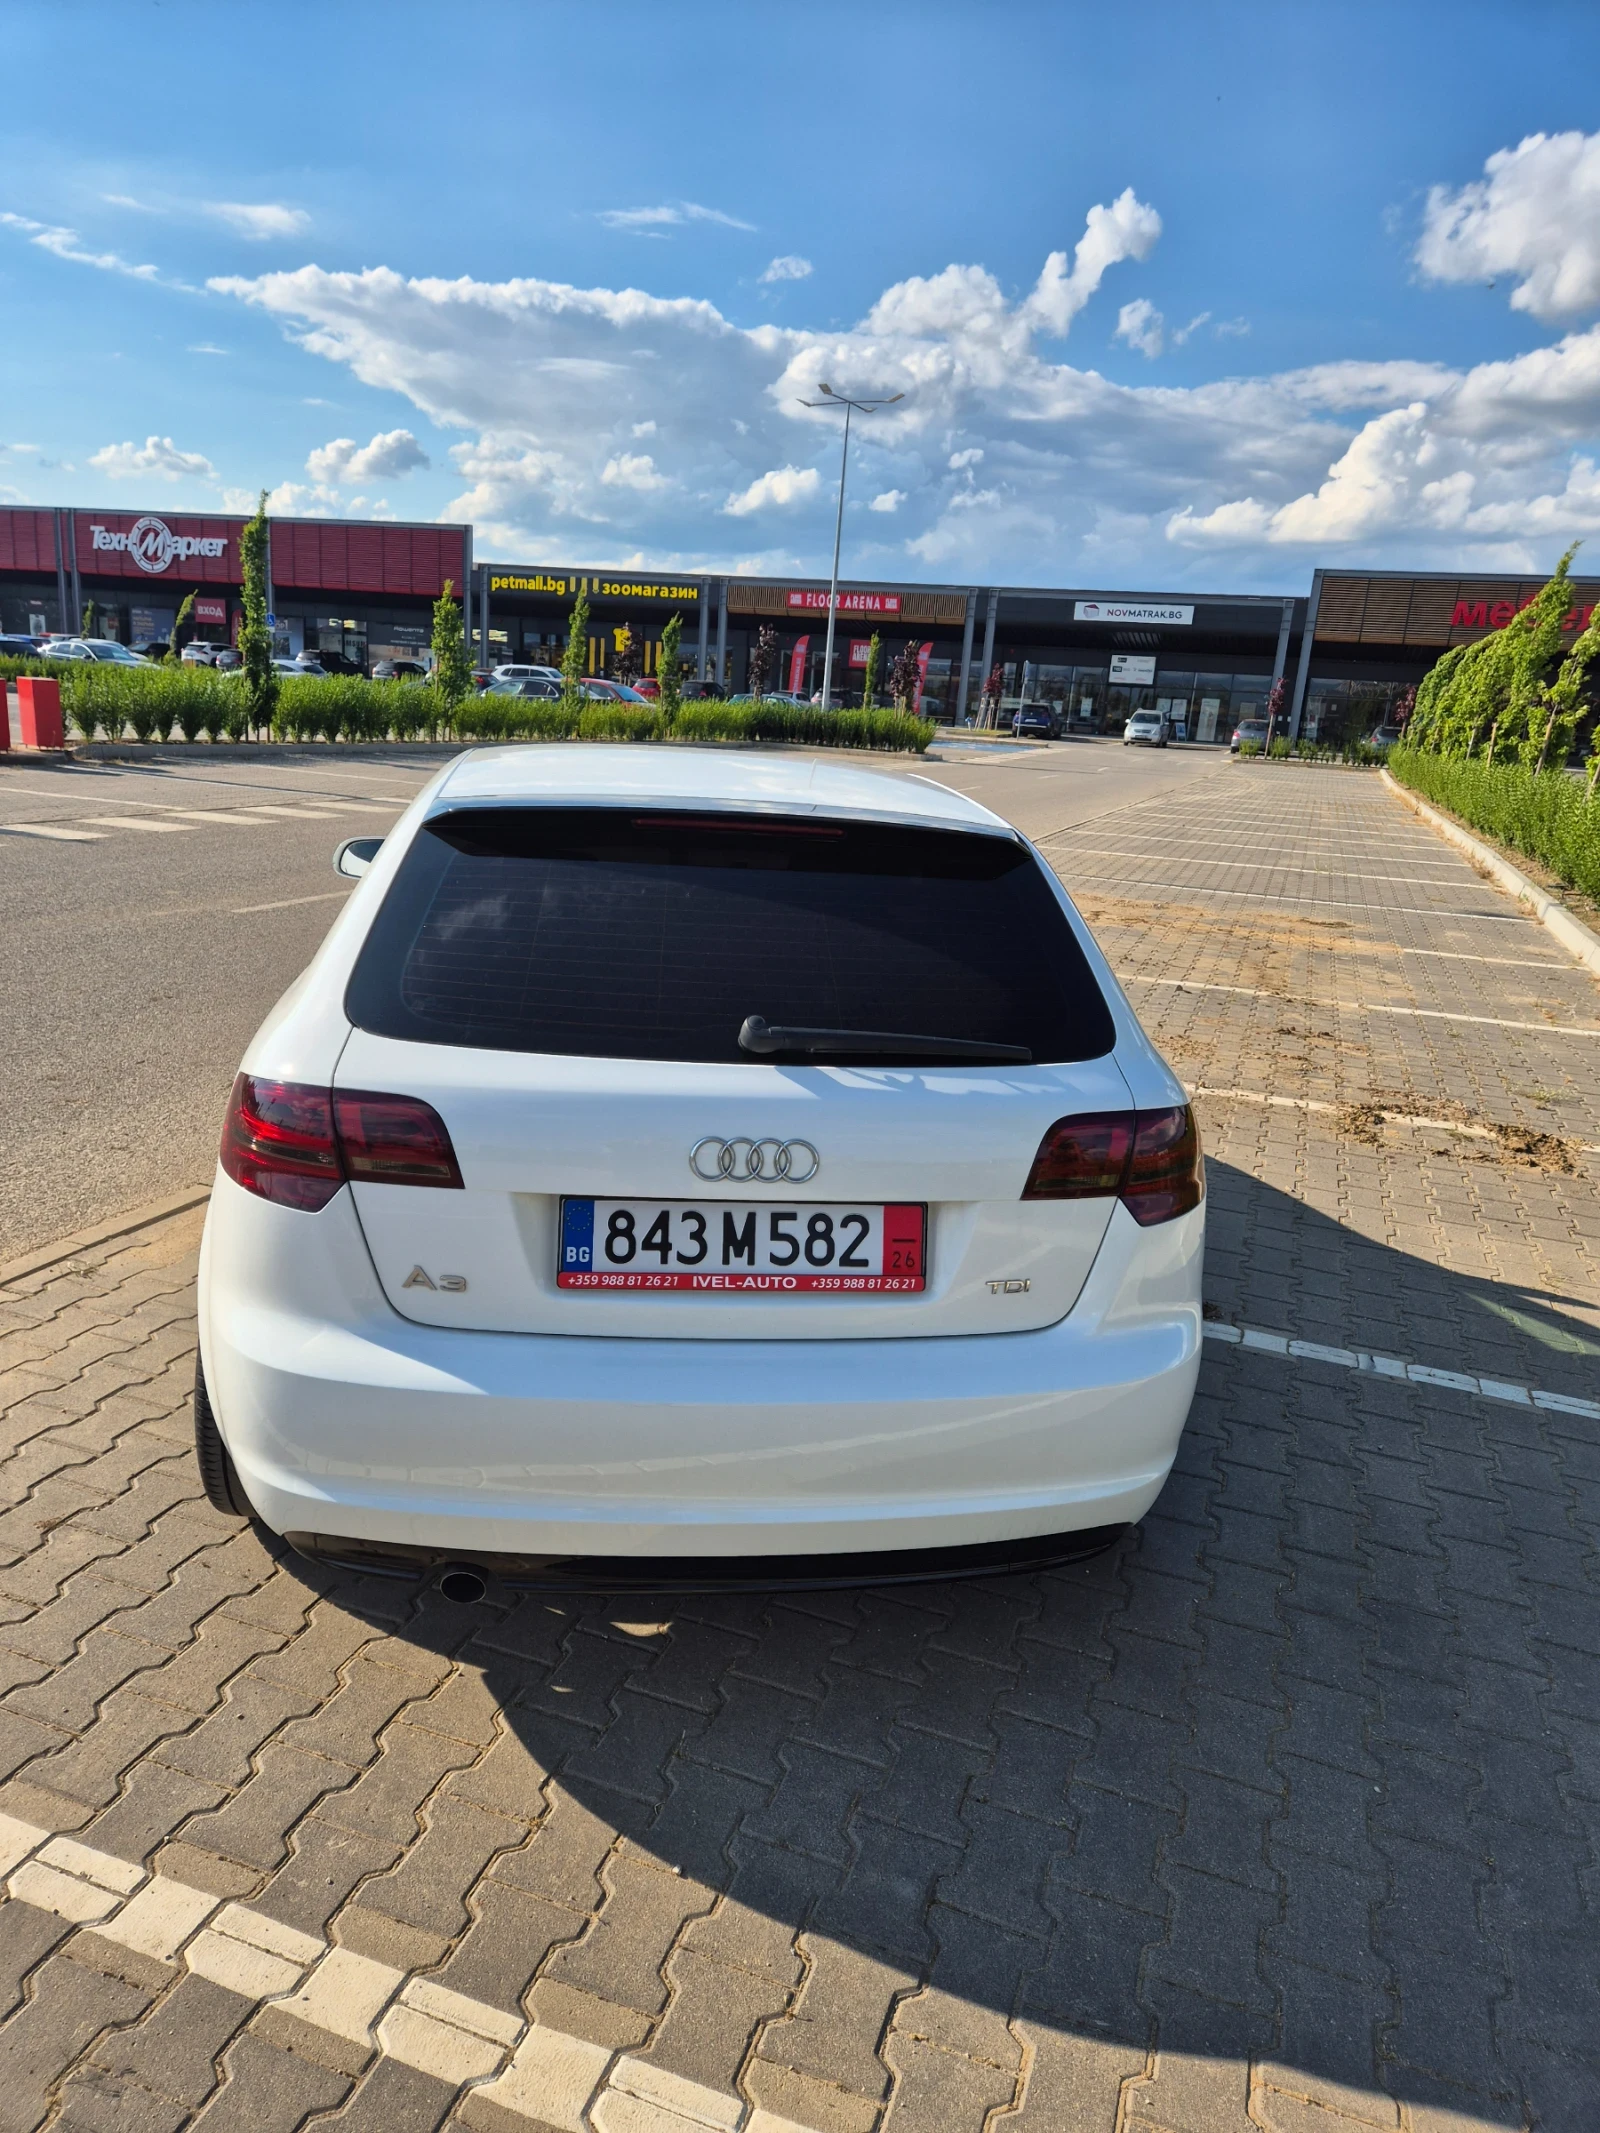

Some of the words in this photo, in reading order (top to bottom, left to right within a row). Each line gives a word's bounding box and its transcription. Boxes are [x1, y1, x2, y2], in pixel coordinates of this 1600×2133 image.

[491, 576, 565, 595] petmall.bg
[602, 583, 698, 599] зоомагазин
[844, 595, 880, 610] ARENA
[197, 606, 223, 617] ВХОД
[1106, 608, 1183, 619] NOVMATRAK.BG
[604, 1209, 708, 1265] 843
[722, 1211, 757, 1266] M
[769, 1212, 870, 1268] 582
[566, 1246, 590, 1263] BG
[891, 1251, 916, 1268] 26
[401, 1264, 467, 1293] A3
[568, 1275, 598, 1286] +359
[601, 1275, 625, 1286] 988
[627, 1275, 641, 1286] 81
[645, 1276, 661, 1286] 26
[663, 1276, 679, 1287] 21
[692, 1275, 797, 1289] IVEL-AUTO
[811, 1278, 840, 1289] +359
[843, 1279, 864, 1289] 988
[867, 1279, 881, 1289] 81
[884, 1278, 899, 1289] 26
[901, 1278, 915, 1289] 21
[985, 1278, 1031, 1294] TDI
